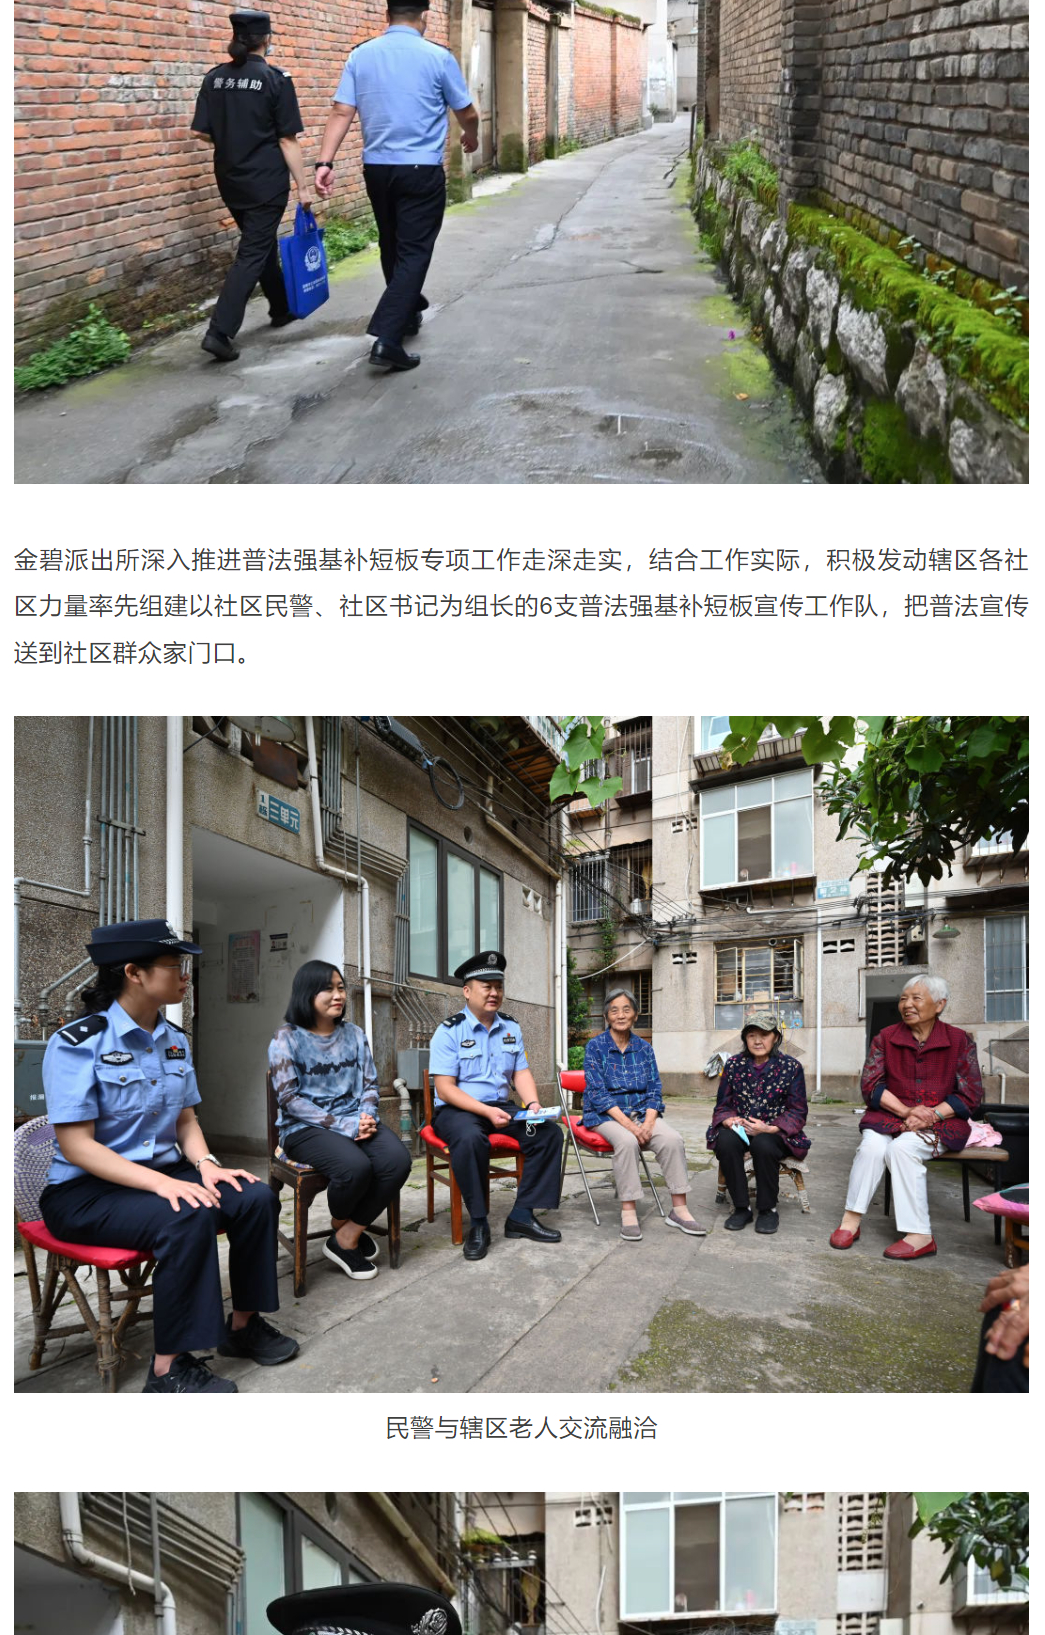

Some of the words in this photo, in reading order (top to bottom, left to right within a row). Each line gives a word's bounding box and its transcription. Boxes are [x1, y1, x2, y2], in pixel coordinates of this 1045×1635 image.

[213, 77, 263, 91] 警务辅助
[269, 799, 299, 832] 三单元
